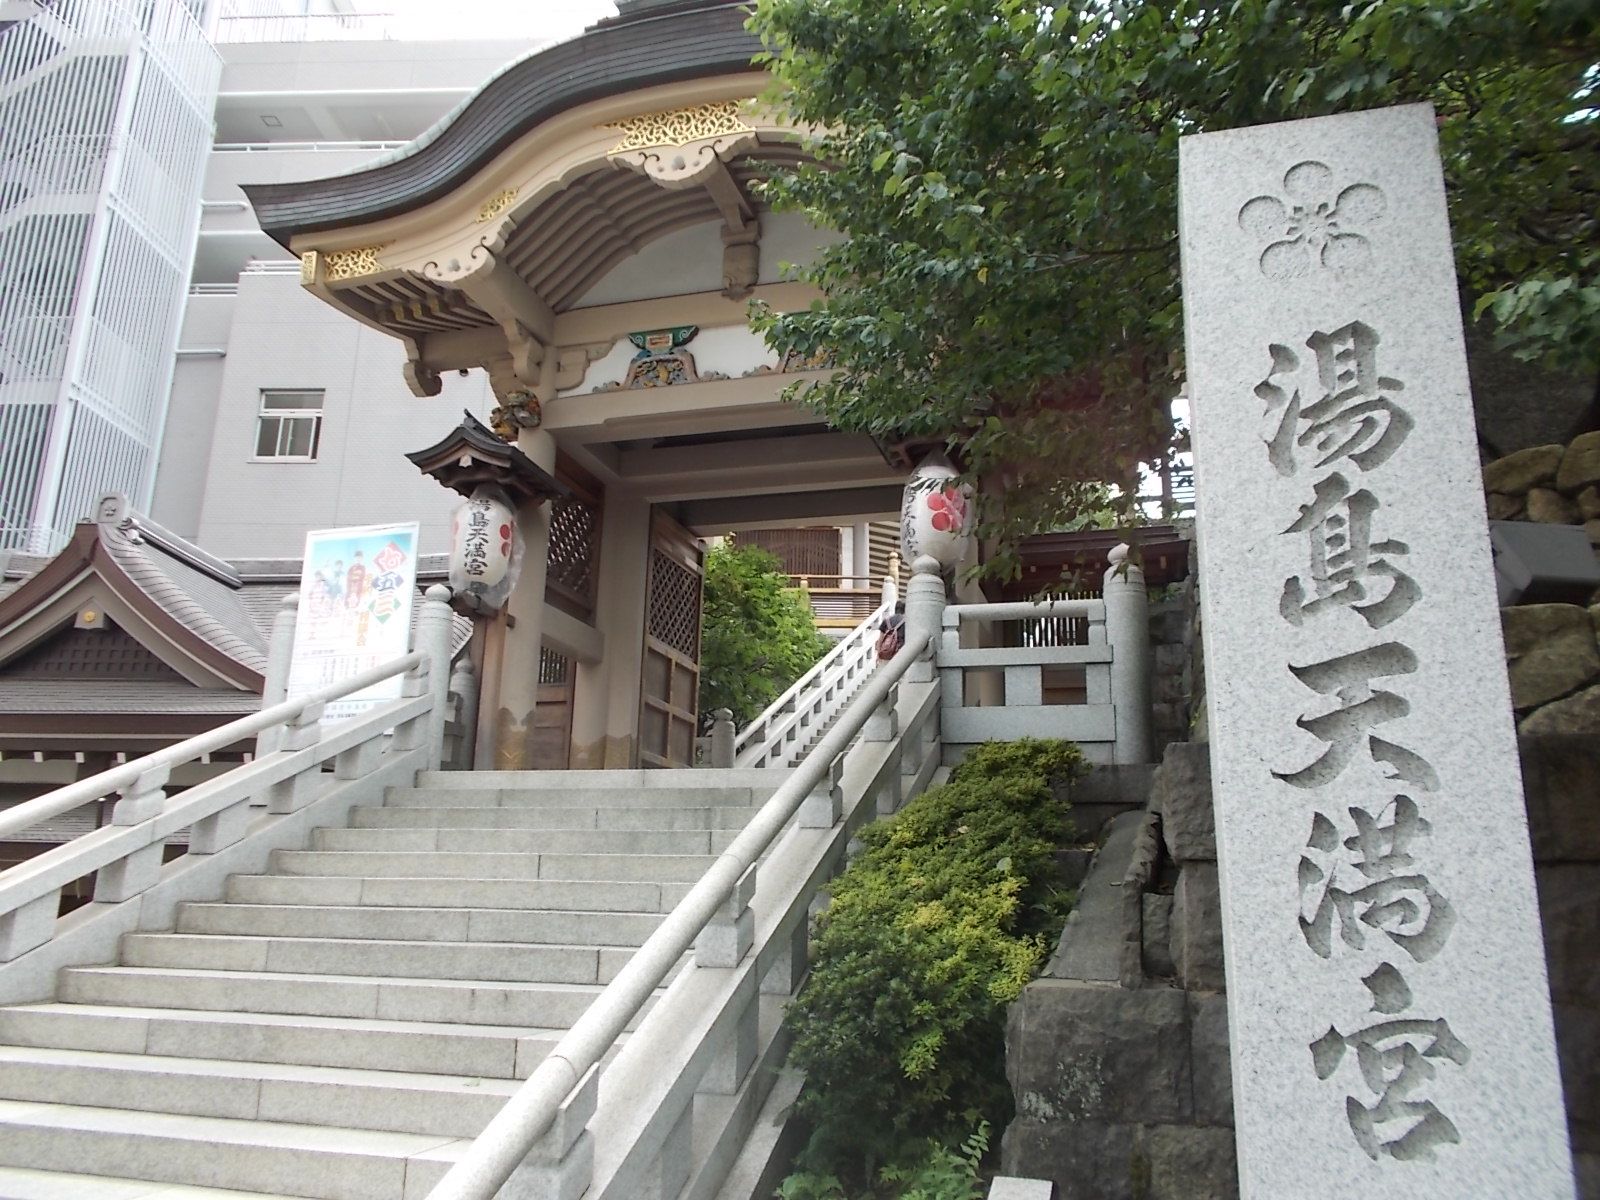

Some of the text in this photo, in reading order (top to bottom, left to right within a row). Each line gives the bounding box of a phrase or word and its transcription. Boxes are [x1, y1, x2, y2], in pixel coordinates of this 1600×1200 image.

[1254, 320, 1471, 1163] 湯島天満宮
